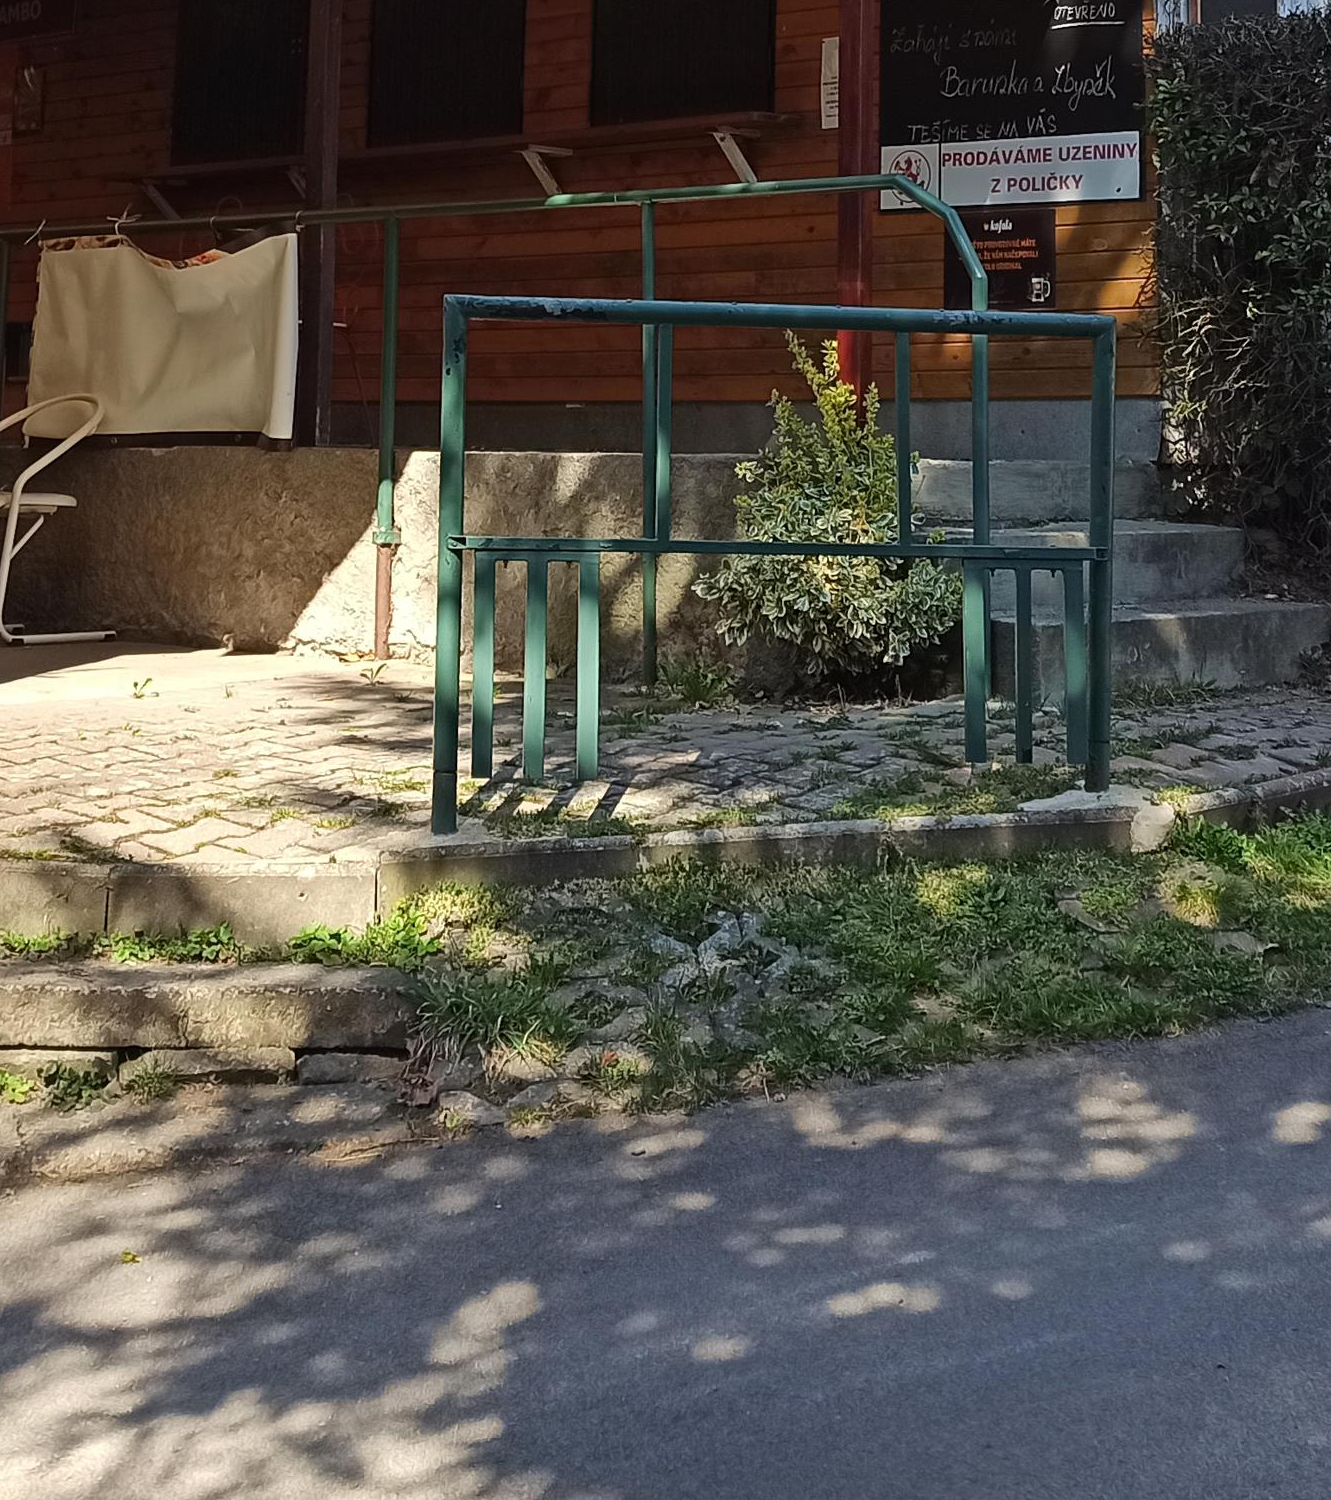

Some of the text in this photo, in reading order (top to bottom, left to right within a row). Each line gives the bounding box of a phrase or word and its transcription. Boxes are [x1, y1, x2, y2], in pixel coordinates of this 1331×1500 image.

[975, 123, 992, 140] SE
[997, 120, 1020, 138] NA
[1026, 108, 1058, 135] VÁS
[942, 142, 1138, 168] PRODÁVÁME UZENINY
[991, 171, 1084, 193] Z POLIČKY
